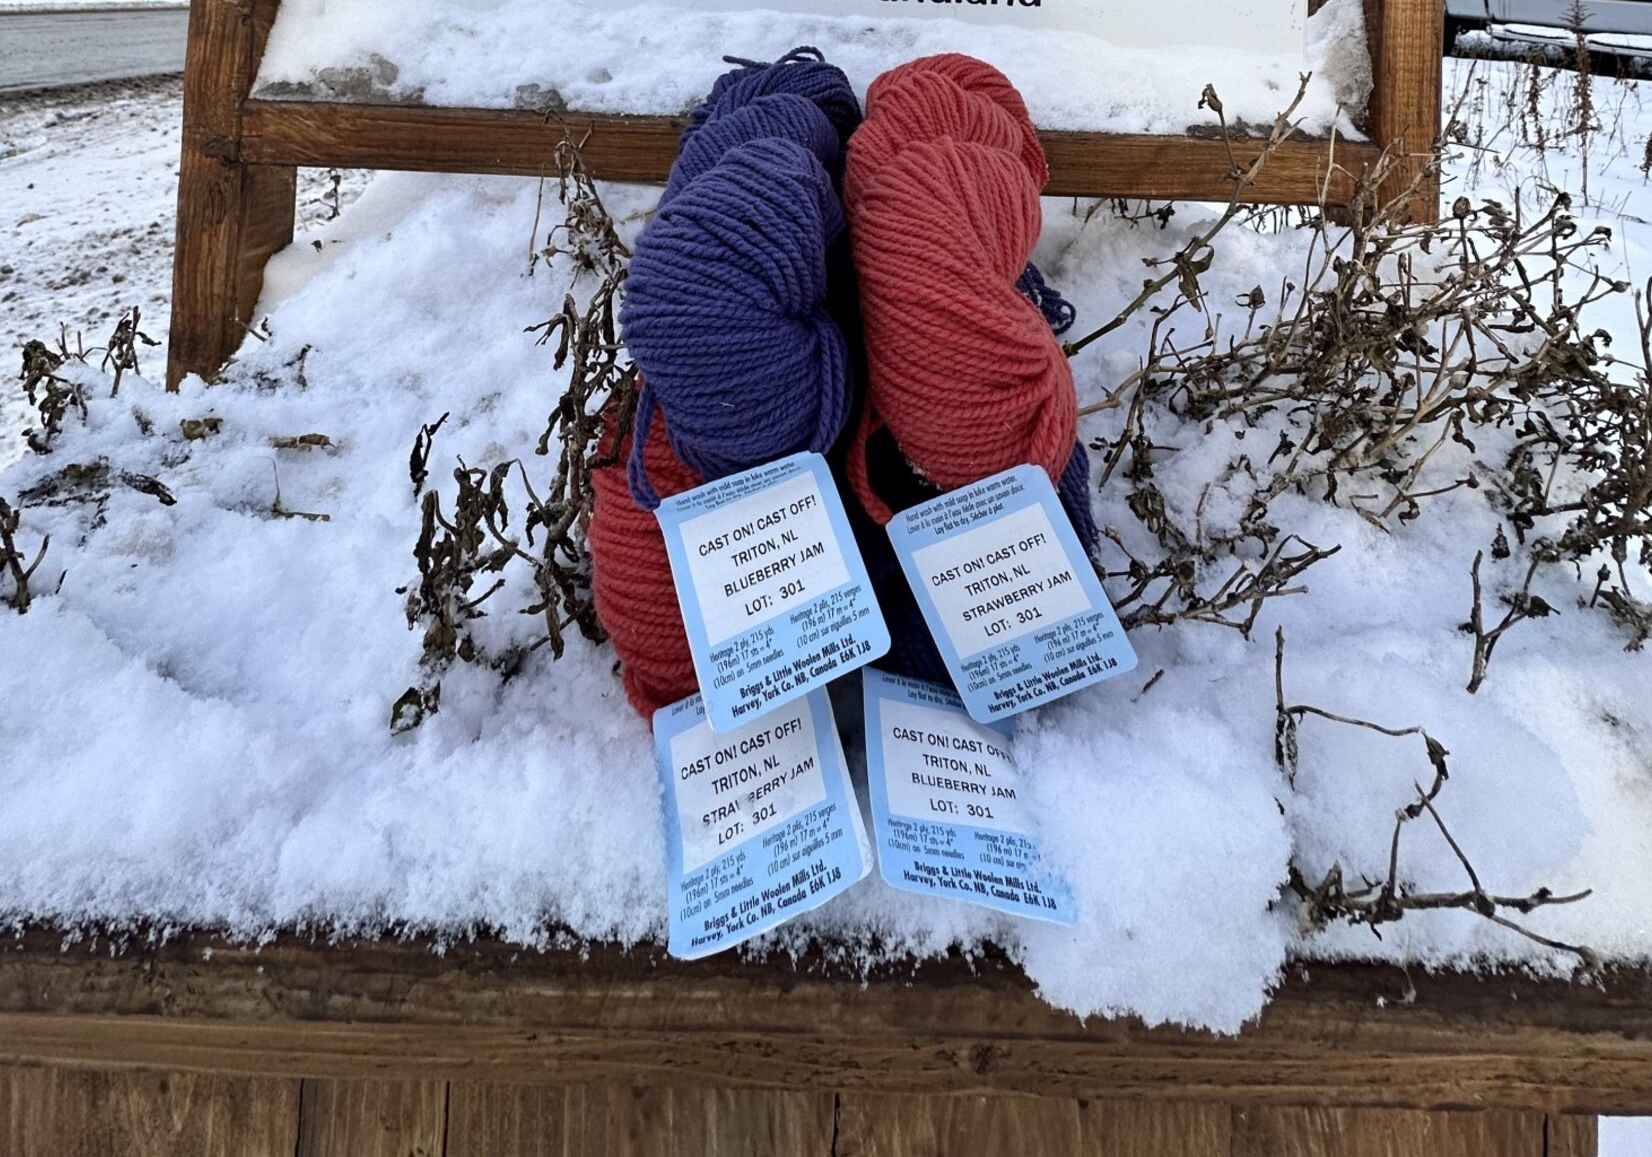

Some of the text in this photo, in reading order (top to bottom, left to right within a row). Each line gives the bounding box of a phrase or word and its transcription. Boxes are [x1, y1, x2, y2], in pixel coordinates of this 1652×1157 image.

[698, 494, 817, 557] CAST ON! CAST OFF!
[731, 529, 799, 567] TRITON, NL
[724, 541, 825, 597] BLUEBERRY JAM
[931, 533, 1046, 587] CAST ON! CAST OFF!
[964, 564, 1031, 597] TRITON, NL
[745, 579, 806, 616] LOT: 301
[962, 571, 1072, 622] STRAWBERRY JAM
[984, 606, 1043, 637] LOT: 301
[731, 640, 871, 718] Harvey, York Co. NB, Canada E6K 1J8
[739, 633, 856, 699] Briggs & Little Woolen Mills Ltd.
[987, 657, 1118, 713] Harvey, York Co. NB, Canada E6K 1J8
[993, 652, 1103, 700] Briggs & Little Woolen Mills Ltd.
[681, 717, 802, 780] CAST ON! CAST OFF!
[892, 727, 924, 743] CAST
[927, 733, 949, 748] ON!
[952, 737, 983, 753] CAST
[711, 755, 780, 795] TRITON, NL
[911, 772, 1016, 800] BLUEBERRY JAM
[922, 753, 991, 777] TRITON, NL
[702, 756, 814, 826] STRABERRY JAM
[929, 798, 994, 819] LOT: 301
[718, 803, 777, 845] LOT: 301
[704, 859, 827, 931] Briggs & Little Woolen Mills Ltd.
[903, 870, 1057, 910] Harvey, York Co. NB, Canada E6K 1J8
[914, 861, 1042, 894] Briggs & Little Woolen Mills Ltd.
[691, 866, 842, 947] Harvey, York Co. NB, Canada E6K 1J8
